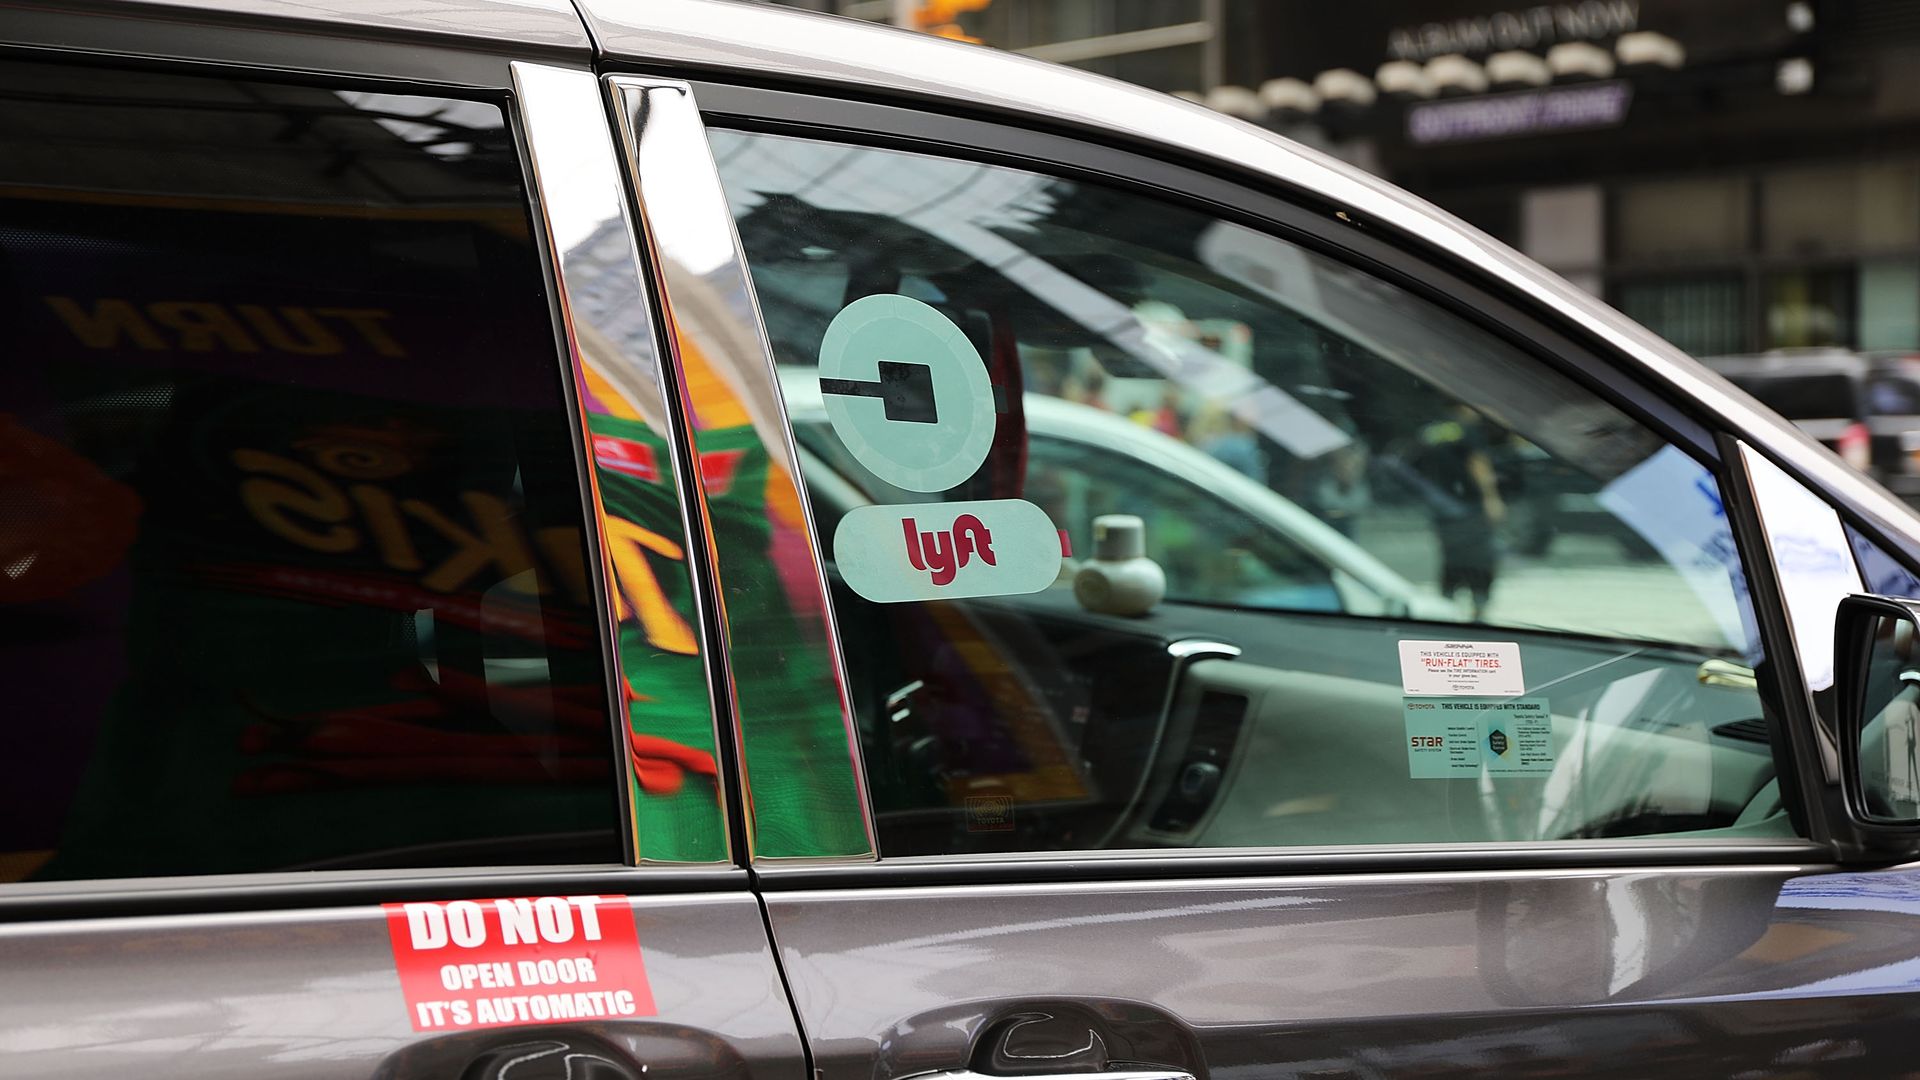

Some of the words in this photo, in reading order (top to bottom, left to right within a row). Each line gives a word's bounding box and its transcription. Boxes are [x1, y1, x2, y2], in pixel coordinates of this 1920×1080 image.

[902, 513, 997, 587] lyft
[1421, 658, 1473, 668] "RUN-FLAT"
[1474, 659, 1502, 668] TIRES.
[403, 900, 487, 950] DO
[494, 895, 602, 945] NOT
[440, 962, 515, 991] OPEN
[517, 957, 597, 986] DOOR
[416, 999, 472, 1028] IT'S
[477, 990, 636, 1024] AUTOMATIC
